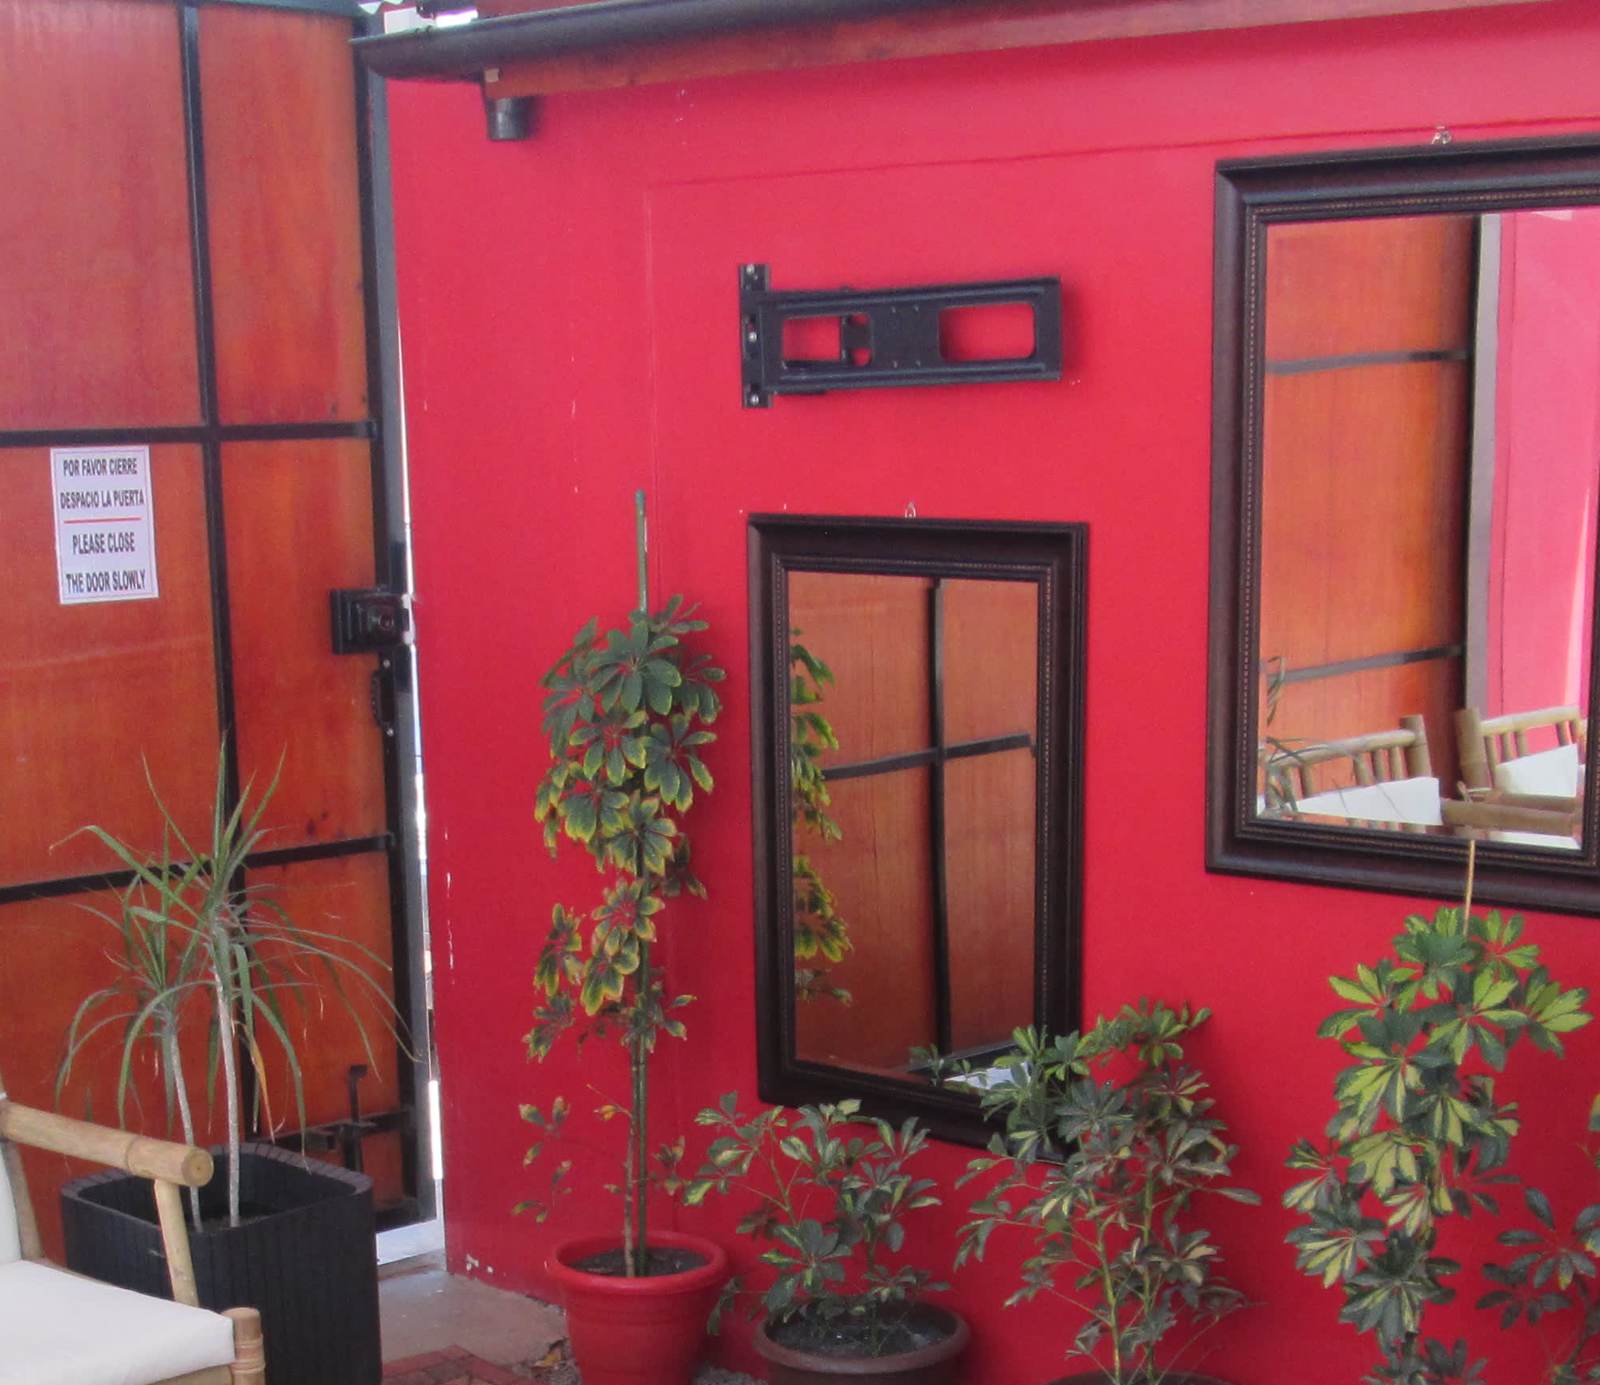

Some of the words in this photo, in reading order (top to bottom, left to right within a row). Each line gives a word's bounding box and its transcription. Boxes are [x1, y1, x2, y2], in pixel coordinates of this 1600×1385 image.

[63, 459, 79, 476] POR
[82, 459, 106, 475] FAVOR
[109, 458, 137, 475] CIERRE
[60, 491, 99, 509] DESPACIO
[101, 491, 112, 508] LA
[113, 489, 144, 507] PUERTA
[72, 533, 105, 554] PLEASE
[107, 532, 135, 553] CLOSE
[66, 573, 83, 593] THE
[86, 571, 110, 592] DOOR
[112, 569, 146, 591] SLOWLY
